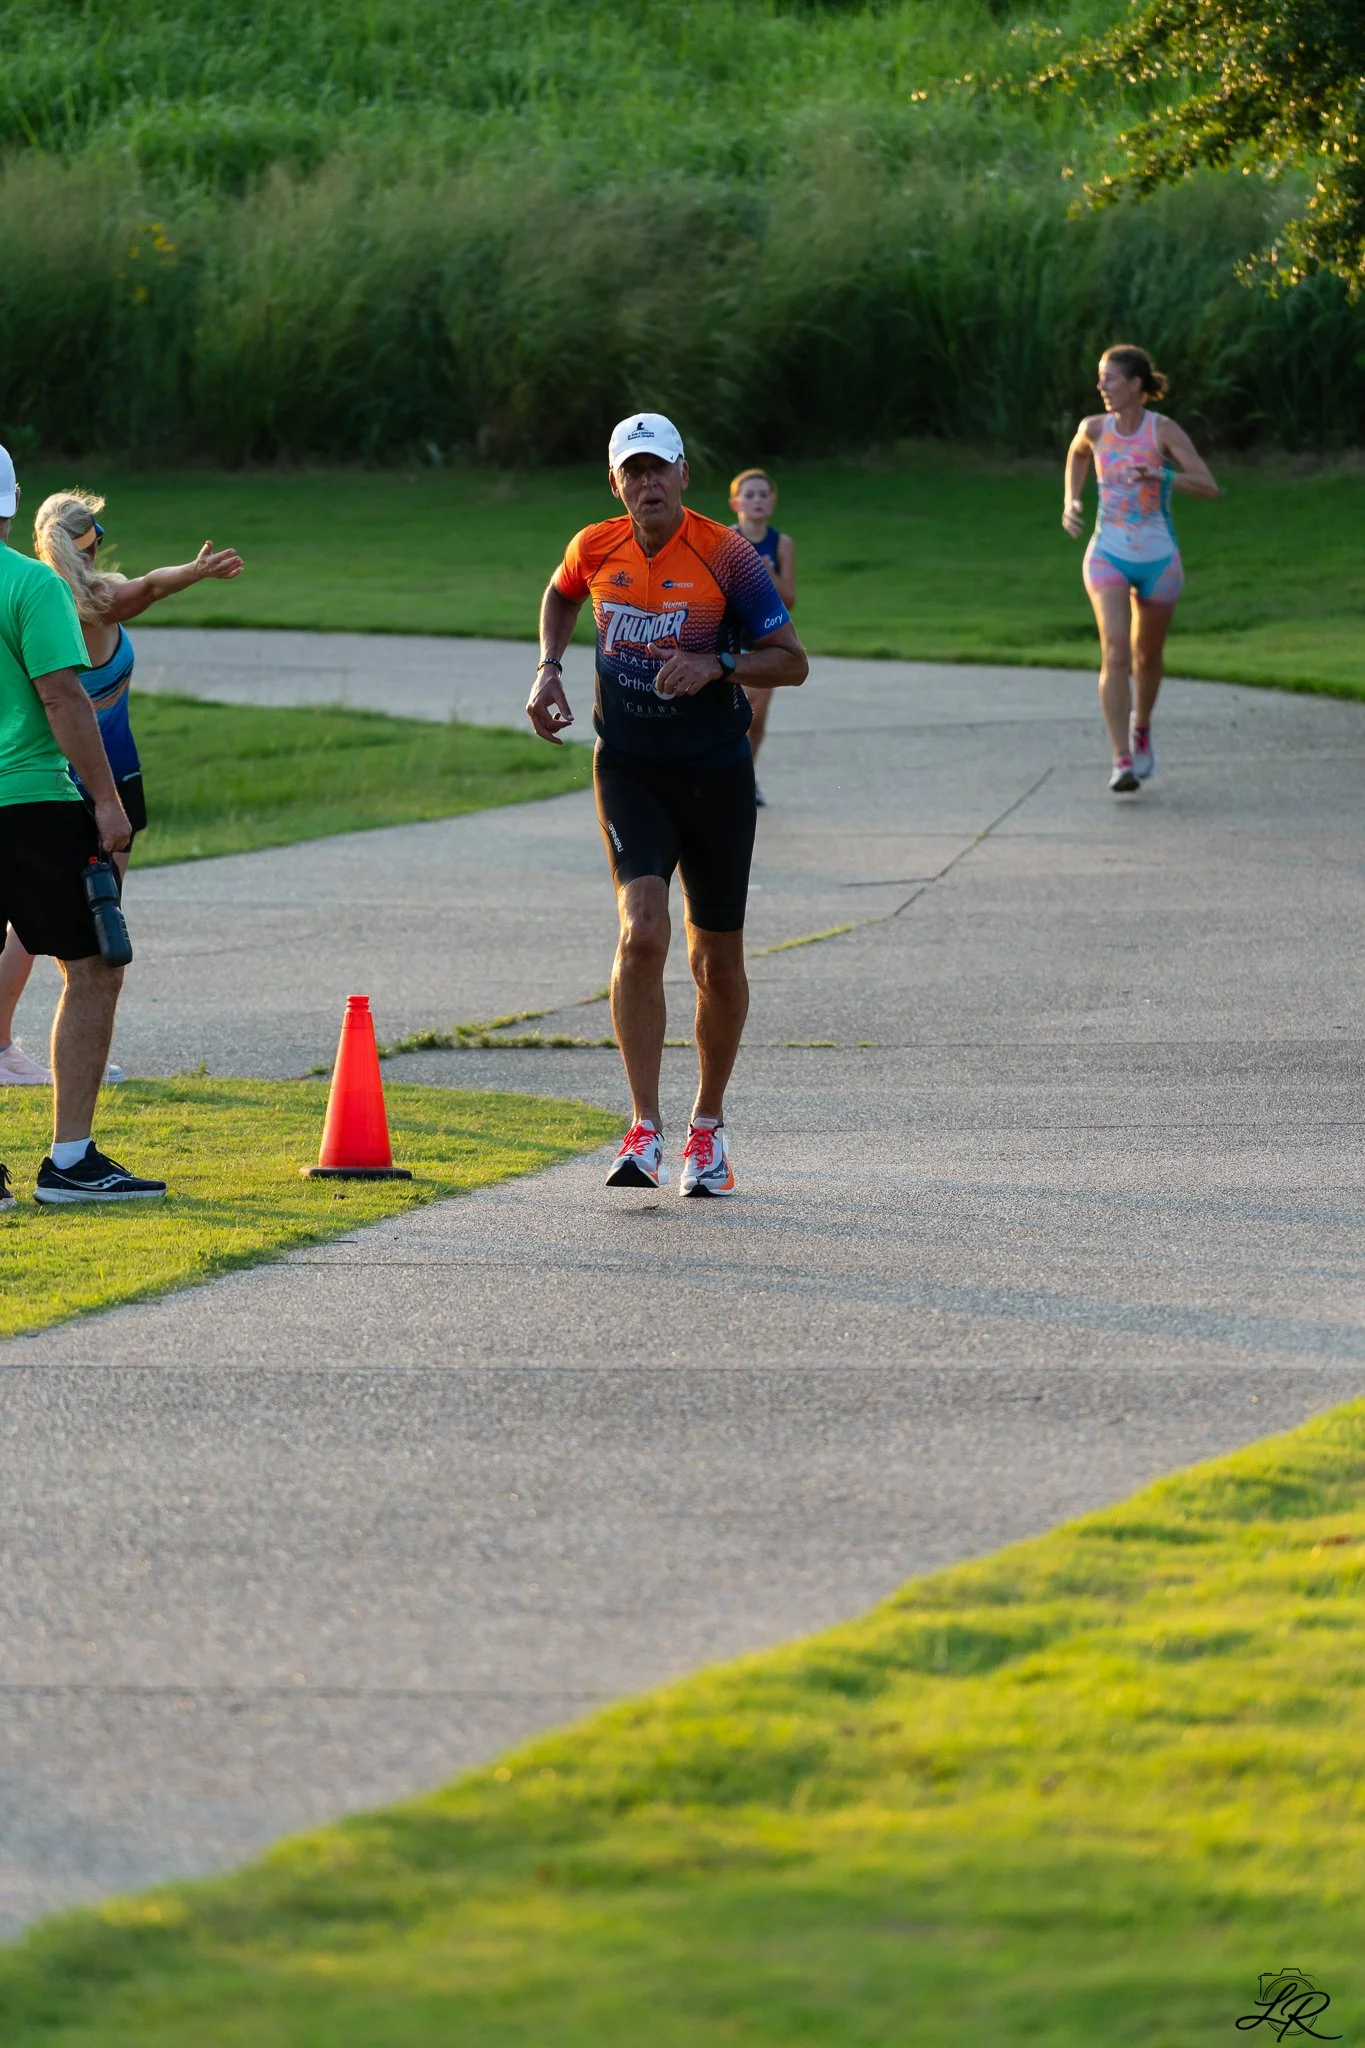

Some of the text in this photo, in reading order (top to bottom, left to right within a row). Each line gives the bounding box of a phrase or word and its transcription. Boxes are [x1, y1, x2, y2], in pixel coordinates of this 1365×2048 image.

[601, 601, 688, 653] THUNDER
[764, 613, 783, 629] Cory
[620, 651, 666, 669] RACIN
[618, 673, 653, 692] Ortho
